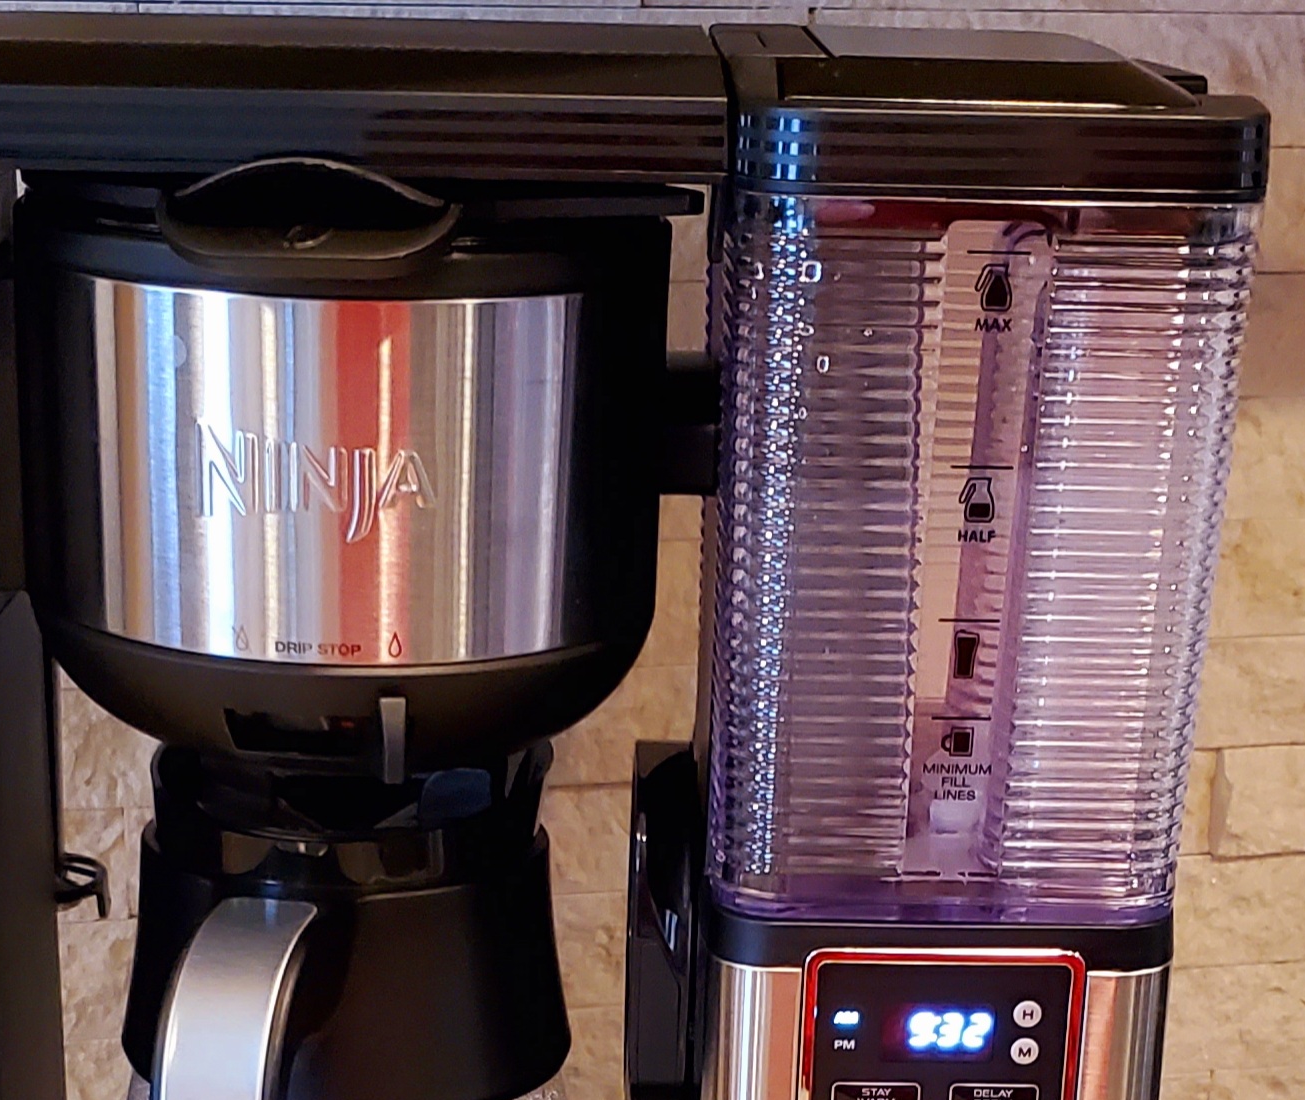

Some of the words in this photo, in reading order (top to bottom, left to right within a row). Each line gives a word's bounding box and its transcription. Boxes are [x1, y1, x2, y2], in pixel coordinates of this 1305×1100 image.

[975, 318, 1012, 332] MAX
[195, 418, 437, 543] NINJA
[957, 530, 996, 543] HALF
[274, 641, 312, 655] DRIP
[317, 643, 362, 657] STOP
[922, 763, 992, 776] MINIMUM
[941, 776, 971, 788] FILL
[934, 789, 976, 801] LINES
[1022, 1008, 1034, 1021] H
[833, 1039, 856, 1050] PM
[1017, 1046, 1032, 1059] M
[861, 1088, 892, 1097] STAY
[973, 1088, 1014, 1098] DELAY
